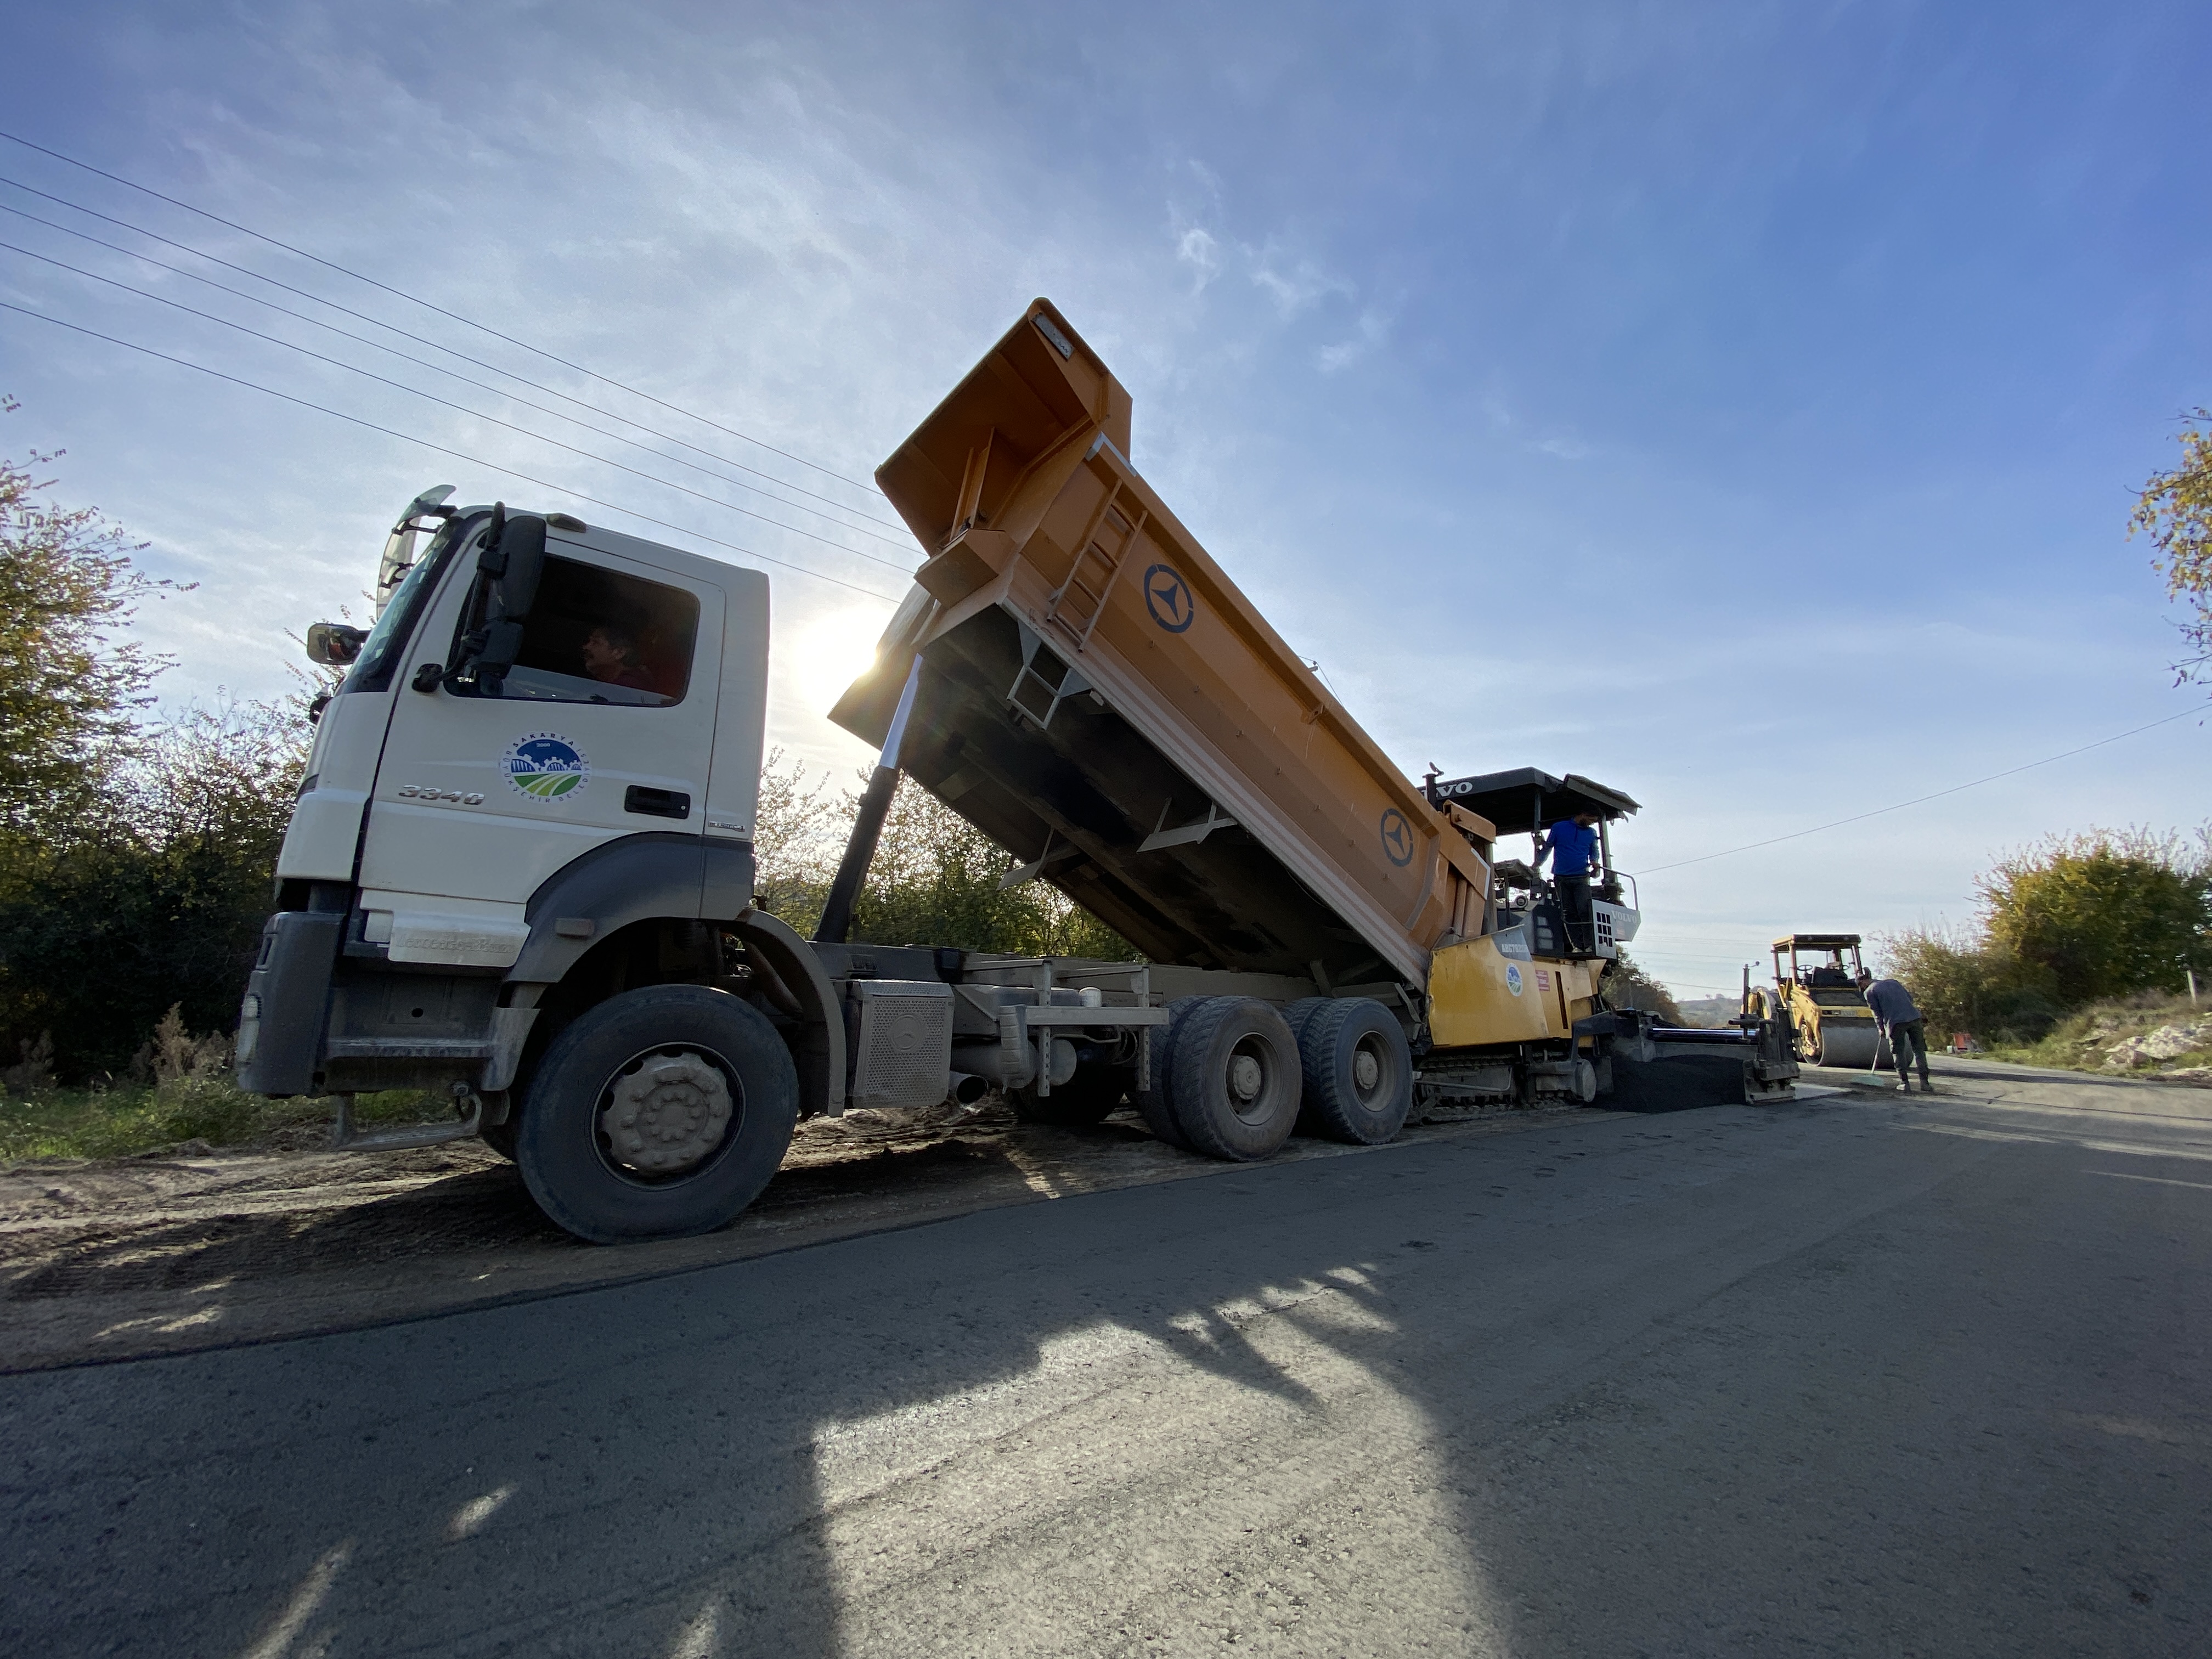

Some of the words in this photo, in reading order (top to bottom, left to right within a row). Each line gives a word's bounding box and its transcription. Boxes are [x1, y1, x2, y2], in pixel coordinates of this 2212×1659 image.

[513, 732, 574, 748] SAKARYA
[399, 785, 485, 805] 3340
[1611, 911, 1637, 924] VOLVO
